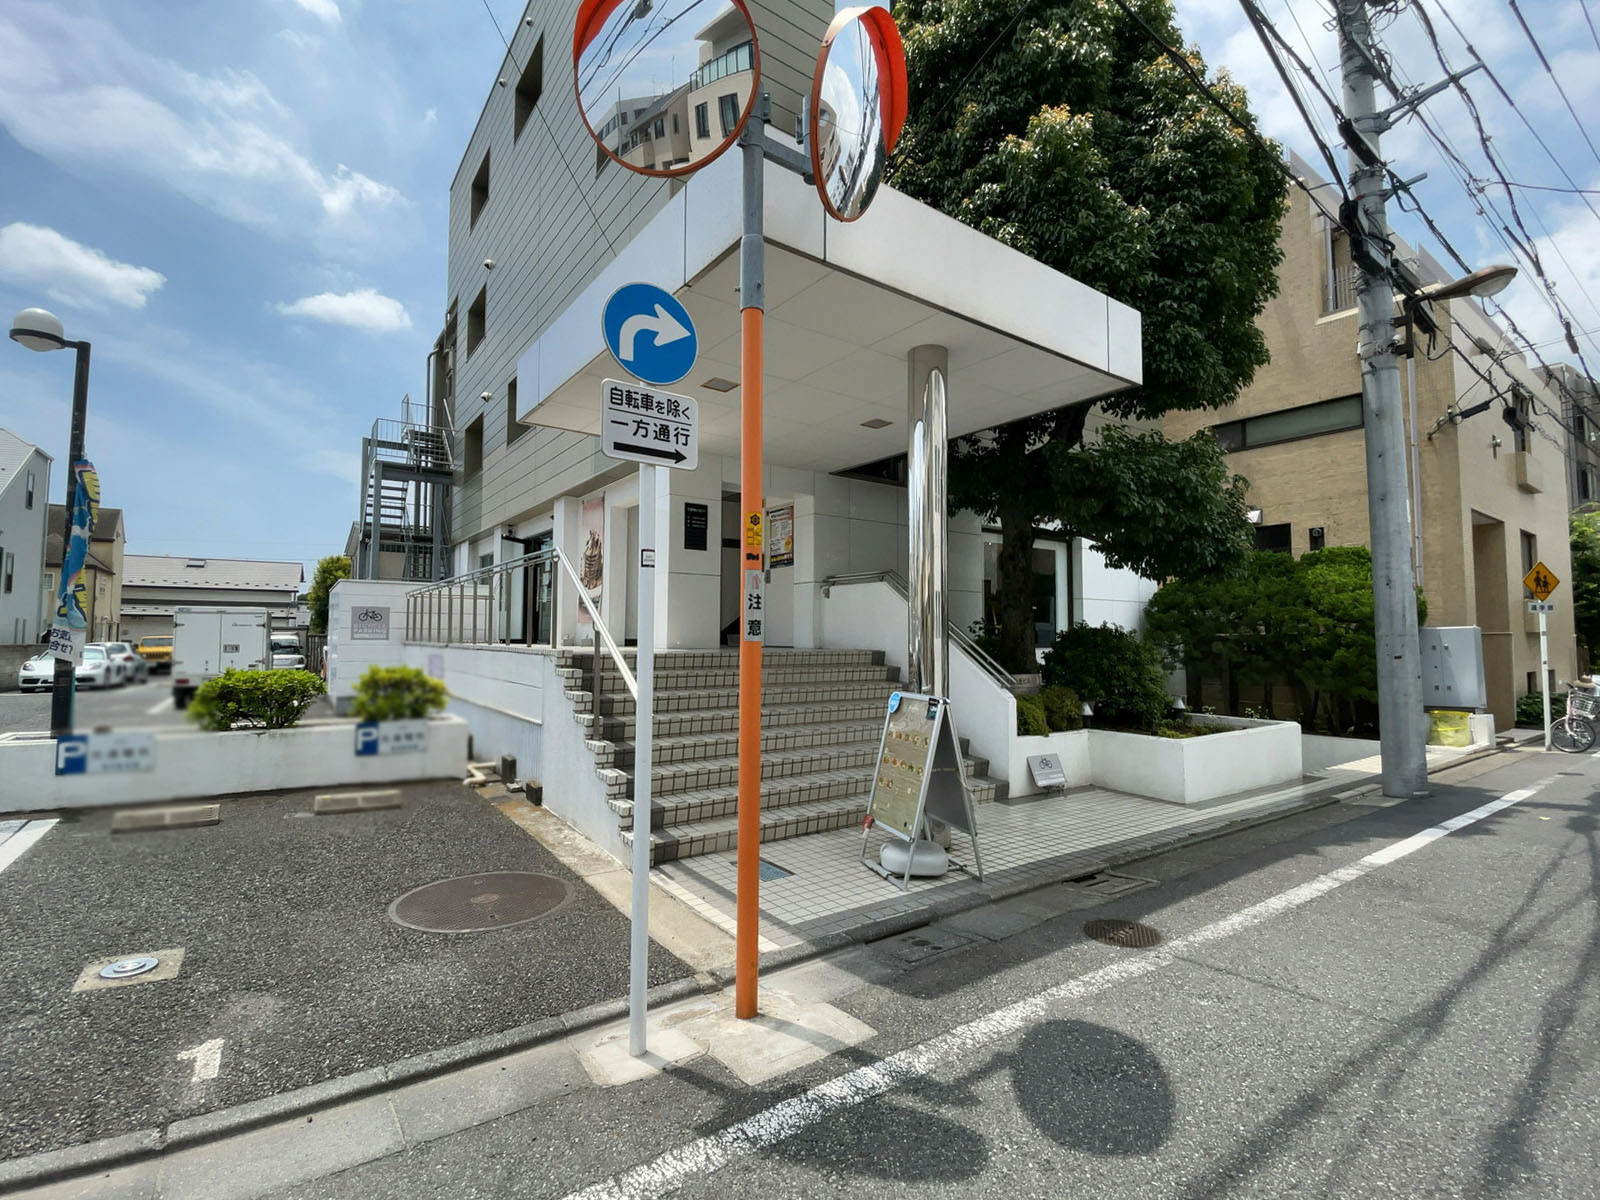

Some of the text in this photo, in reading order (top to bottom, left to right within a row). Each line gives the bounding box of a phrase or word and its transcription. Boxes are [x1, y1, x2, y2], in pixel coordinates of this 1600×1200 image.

[610, 386, 690, 420] 自転車を除く
[610, 419, 690, 446] 一方通行
[747, 593, 762, 636] 注意
[357, 727, 378, 751] P
[58, 742, 86, 768] P
